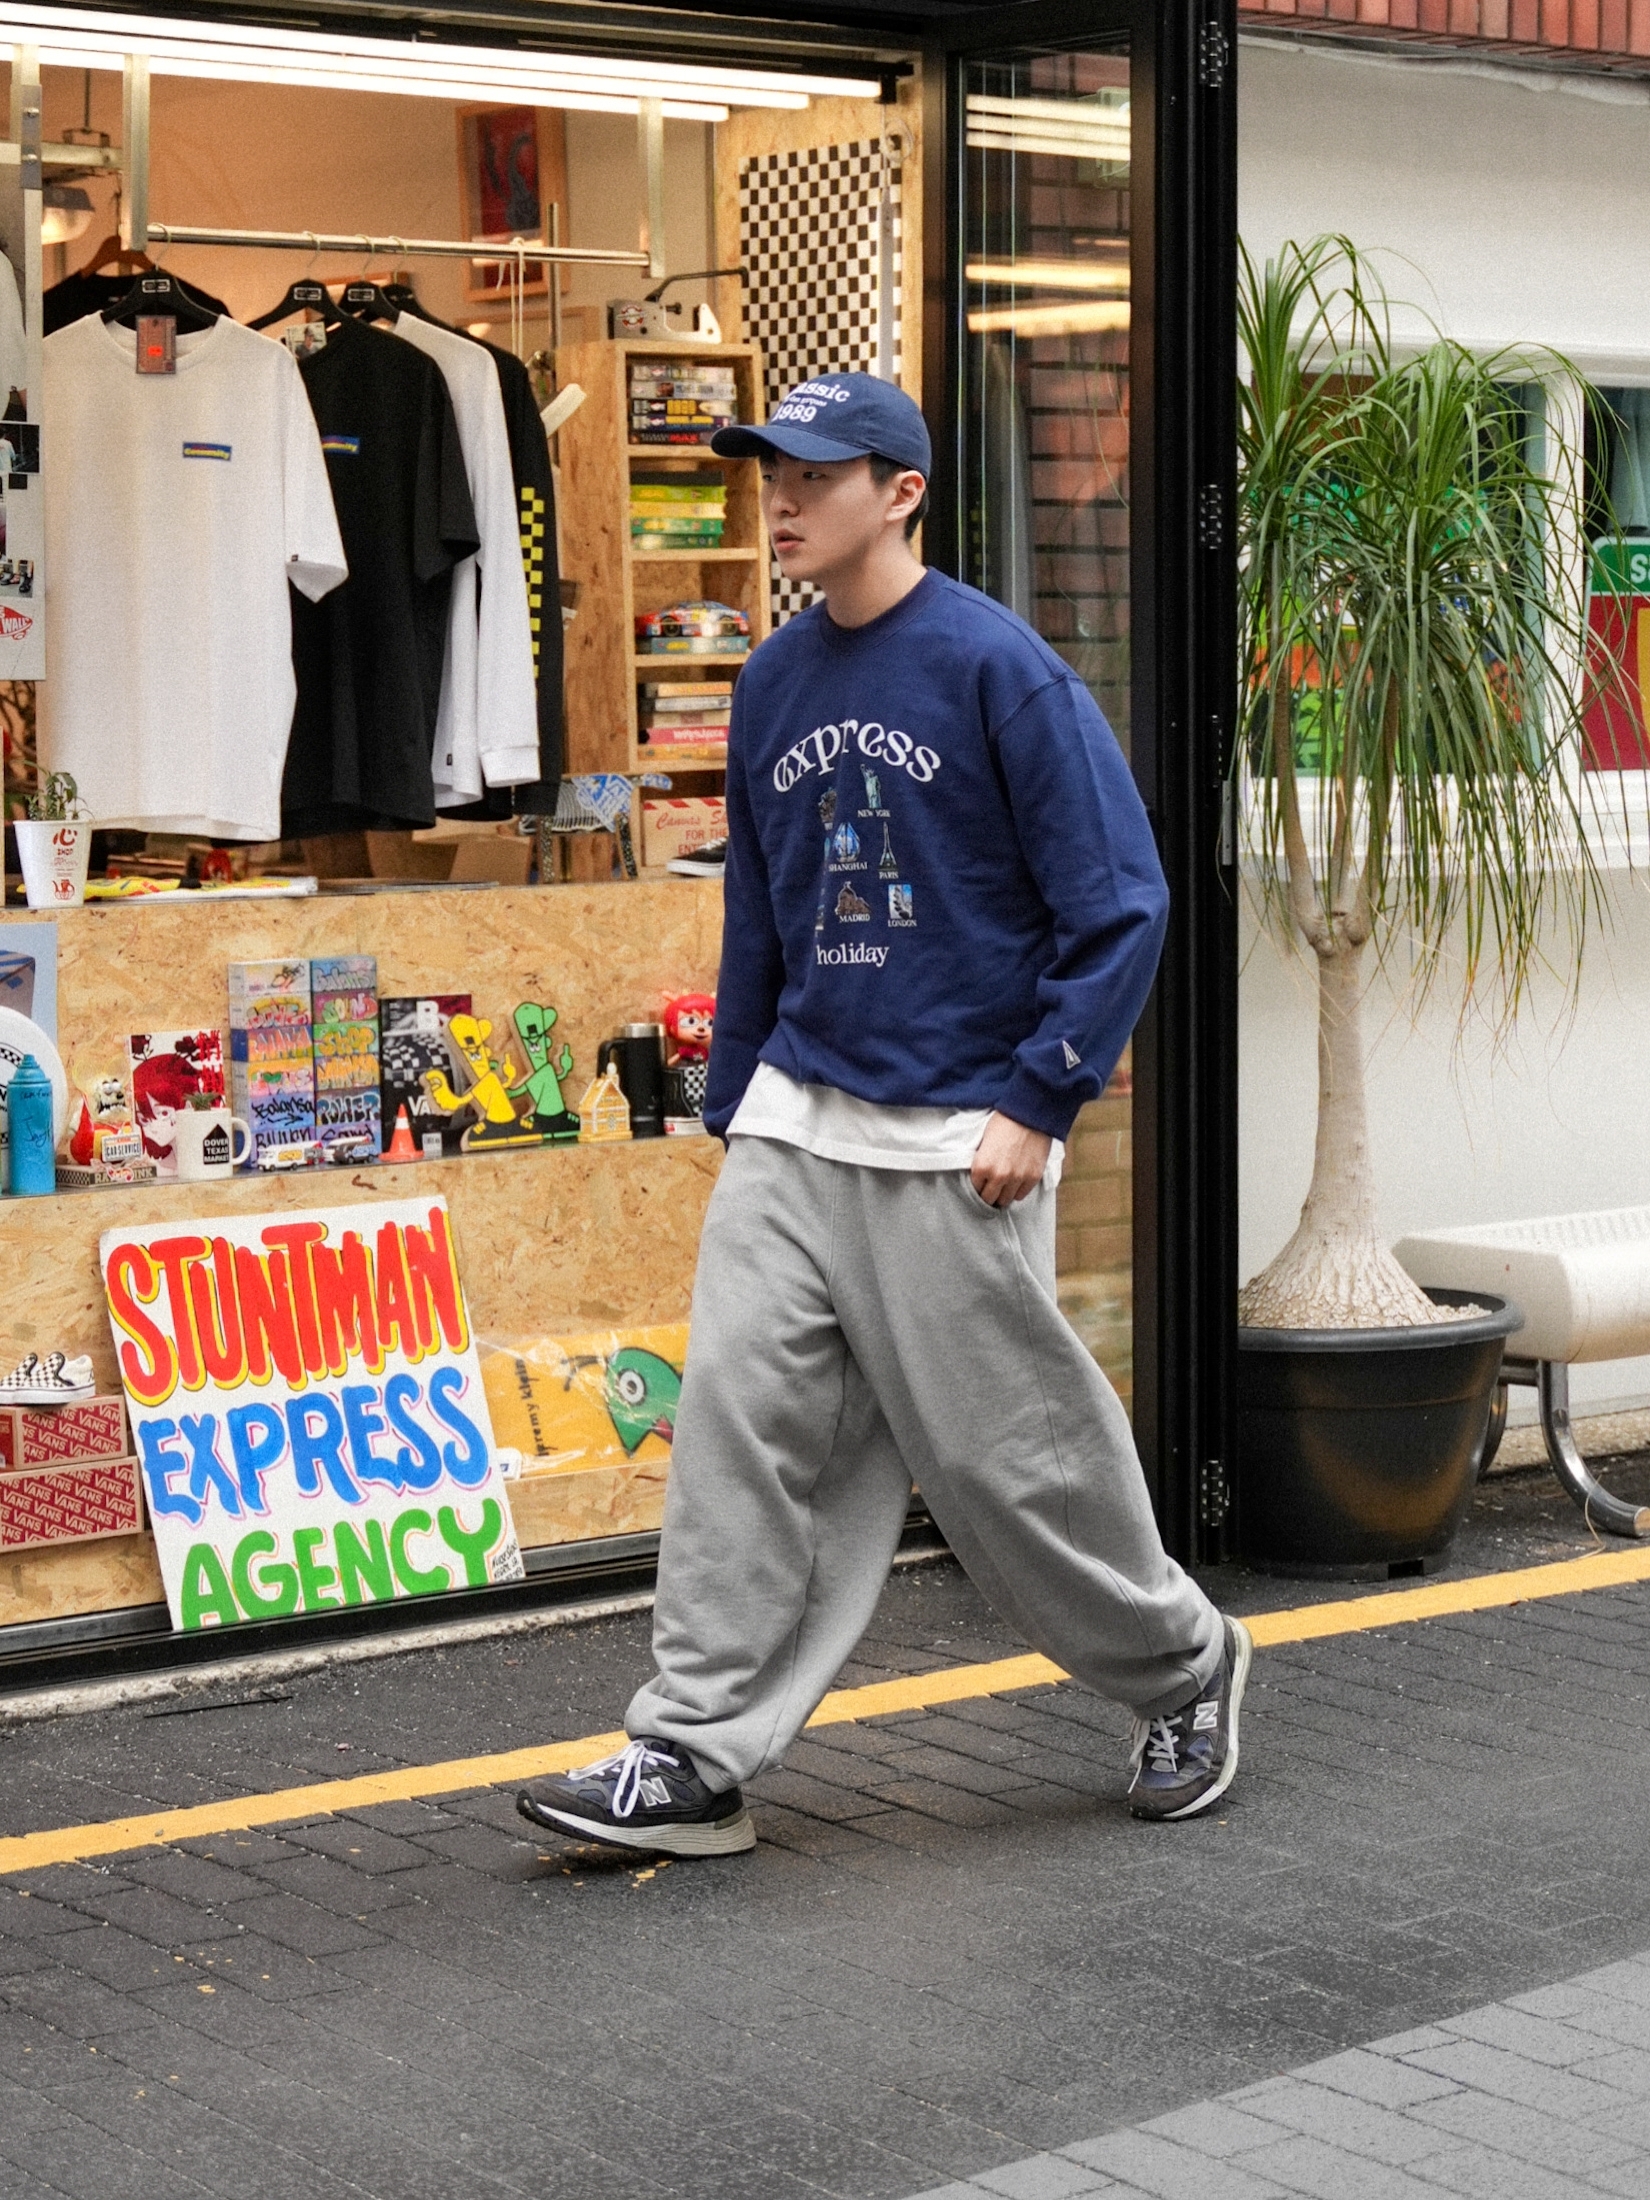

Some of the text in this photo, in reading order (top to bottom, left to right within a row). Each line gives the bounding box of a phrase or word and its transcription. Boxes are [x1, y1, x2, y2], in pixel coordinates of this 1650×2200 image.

[771, 404, 817, 422] 1989
[773, 719, 942, 793] express
[857, 809, 873, 818] NEW
[685, 829, 705, 840] FOR
[828, 861, 868, 872] SHANGHAI
[879, 871, 899, 879] PARIS
[839, 913, 871, 923] MADRID
[888, 919, 917, 928] LONDON
[816, 942, 890, 968] holiday
[317, 1092, 381, 1125] POWER
[204, 1138, 229, 1147] DOVER
[205, 1147, 228, 1155] TEXAS
[204, 1154, 229, 1162] MARKET
[106, 1206, 470, 1405] STUNTMAN
[80, 1410, 109, 1433] VANS
[100, 1404, 120, 1422] VAN
[38, 1428, 68, 1451] VANS
[59, 1420, 88, 1442] VANS
[24, 1440, 47, 1460] ANS
[138, 1366, 491, 1525] EXPRESS
[95, 1473, 125, 1496] VANS
[115, 1466, 134, 1484] VAN
[3, 1487, 33, 1511] VANS
[34, 1500, 64, 1522] VANS
[24, 1479, 53, 1501] VANS
[54, 1491, 84, 1514] VANS
[85, 1503, 115, 1526] VANS
[75, 1482, 105, 1505] VANS
[105, 1494, 135, 1517] VANS
[0, 1521, 23, 1541] ANS
[14, 1509, 43, 1531] VANS
[180, 1497, 502, 1630] AGENCY
[1193, 1700, 1219, 1730] N
[640, 1776, 672, 1807] N
